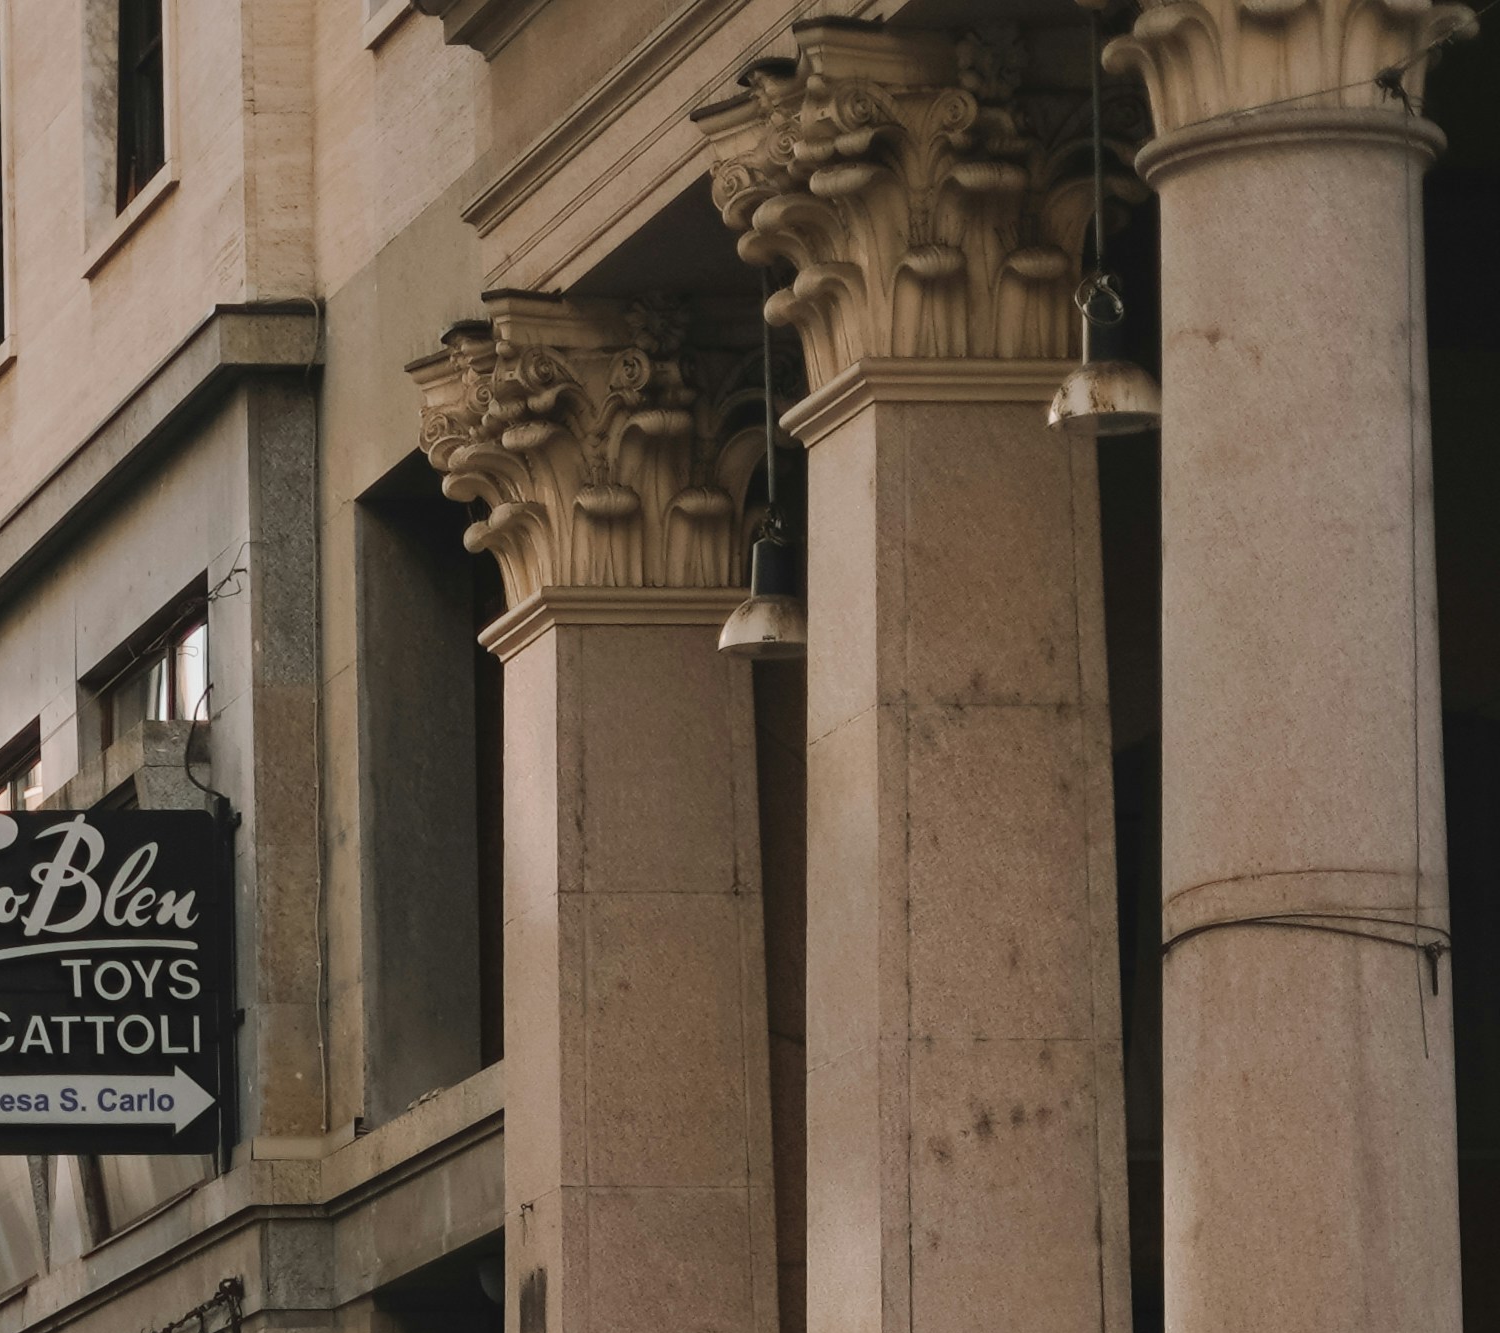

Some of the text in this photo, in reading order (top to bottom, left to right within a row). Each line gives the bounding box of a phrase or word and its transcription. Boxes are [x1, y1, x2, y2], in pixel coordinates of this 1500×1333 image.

[61, 959, 200, 999] TOYS
[59, 1088, 87, 1112] S.
[98, 1088, 175, 1112] Carlo
